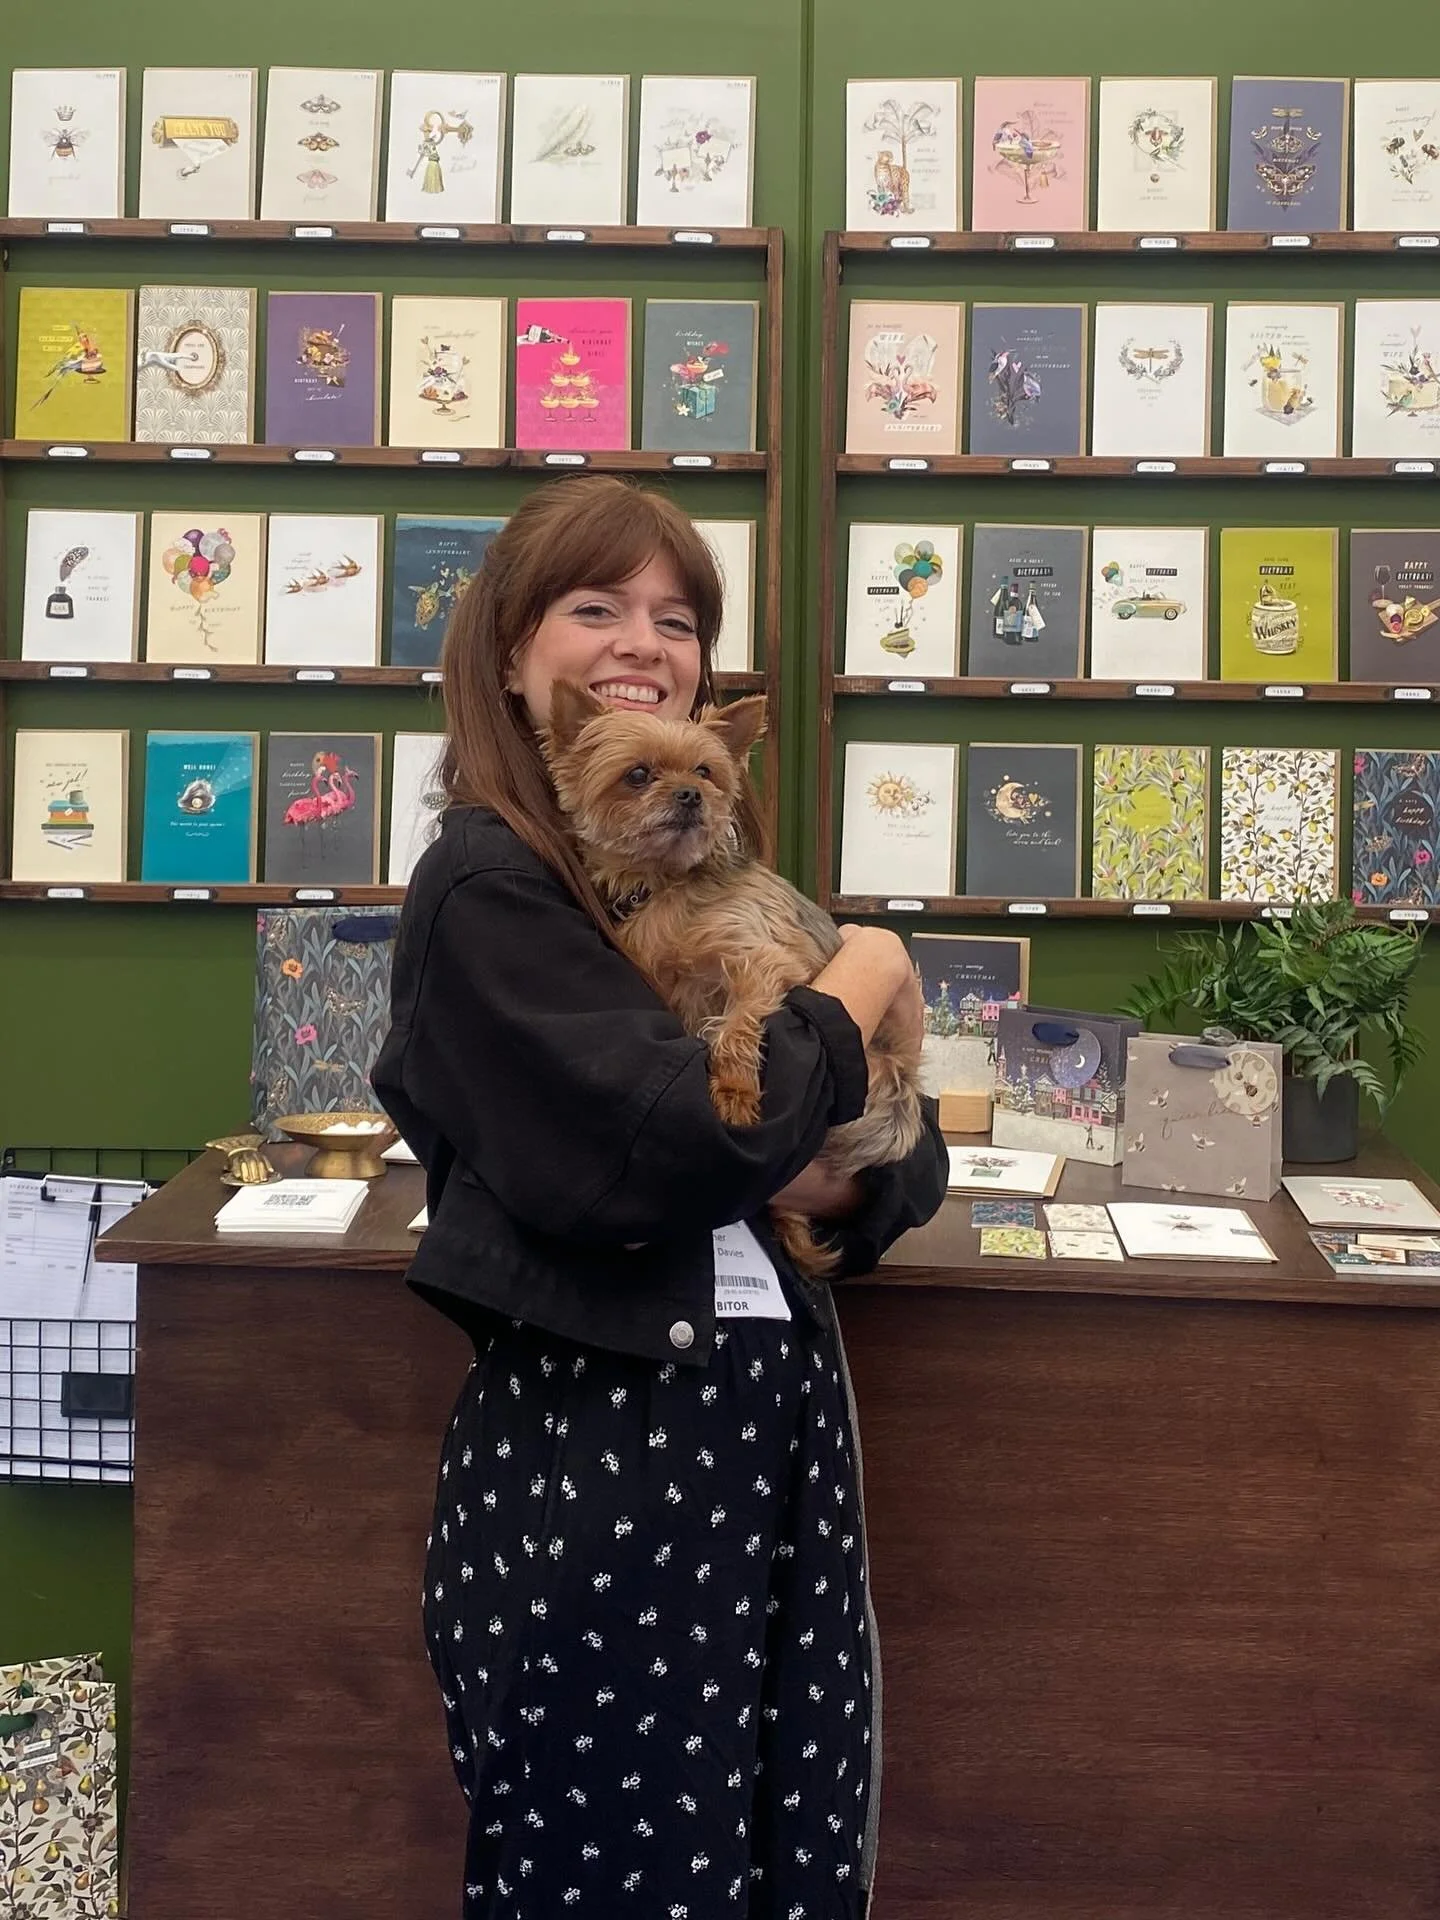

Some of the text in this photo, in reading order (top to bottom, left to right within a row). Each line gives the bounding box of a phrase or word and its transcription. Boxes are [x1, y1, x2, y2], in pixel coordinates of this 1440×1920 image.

[675, 329, 703, 338] birthday
[879, 334, 904, 342] WIFE
[1404, 561, 1428, 570] HAPPY
[1397, 572, 1432, 580] BIRTHDAY!
[170, 604, 194, 612] HAPPY
[1403, 806, 1424, 815] happy
[1395, 816, 1431, 826] birthday!
[1019, 831, 1030, 840] you
[717, 1247, 744, 1258] Davies
[717, 1301, 749, 1311] BITOR
